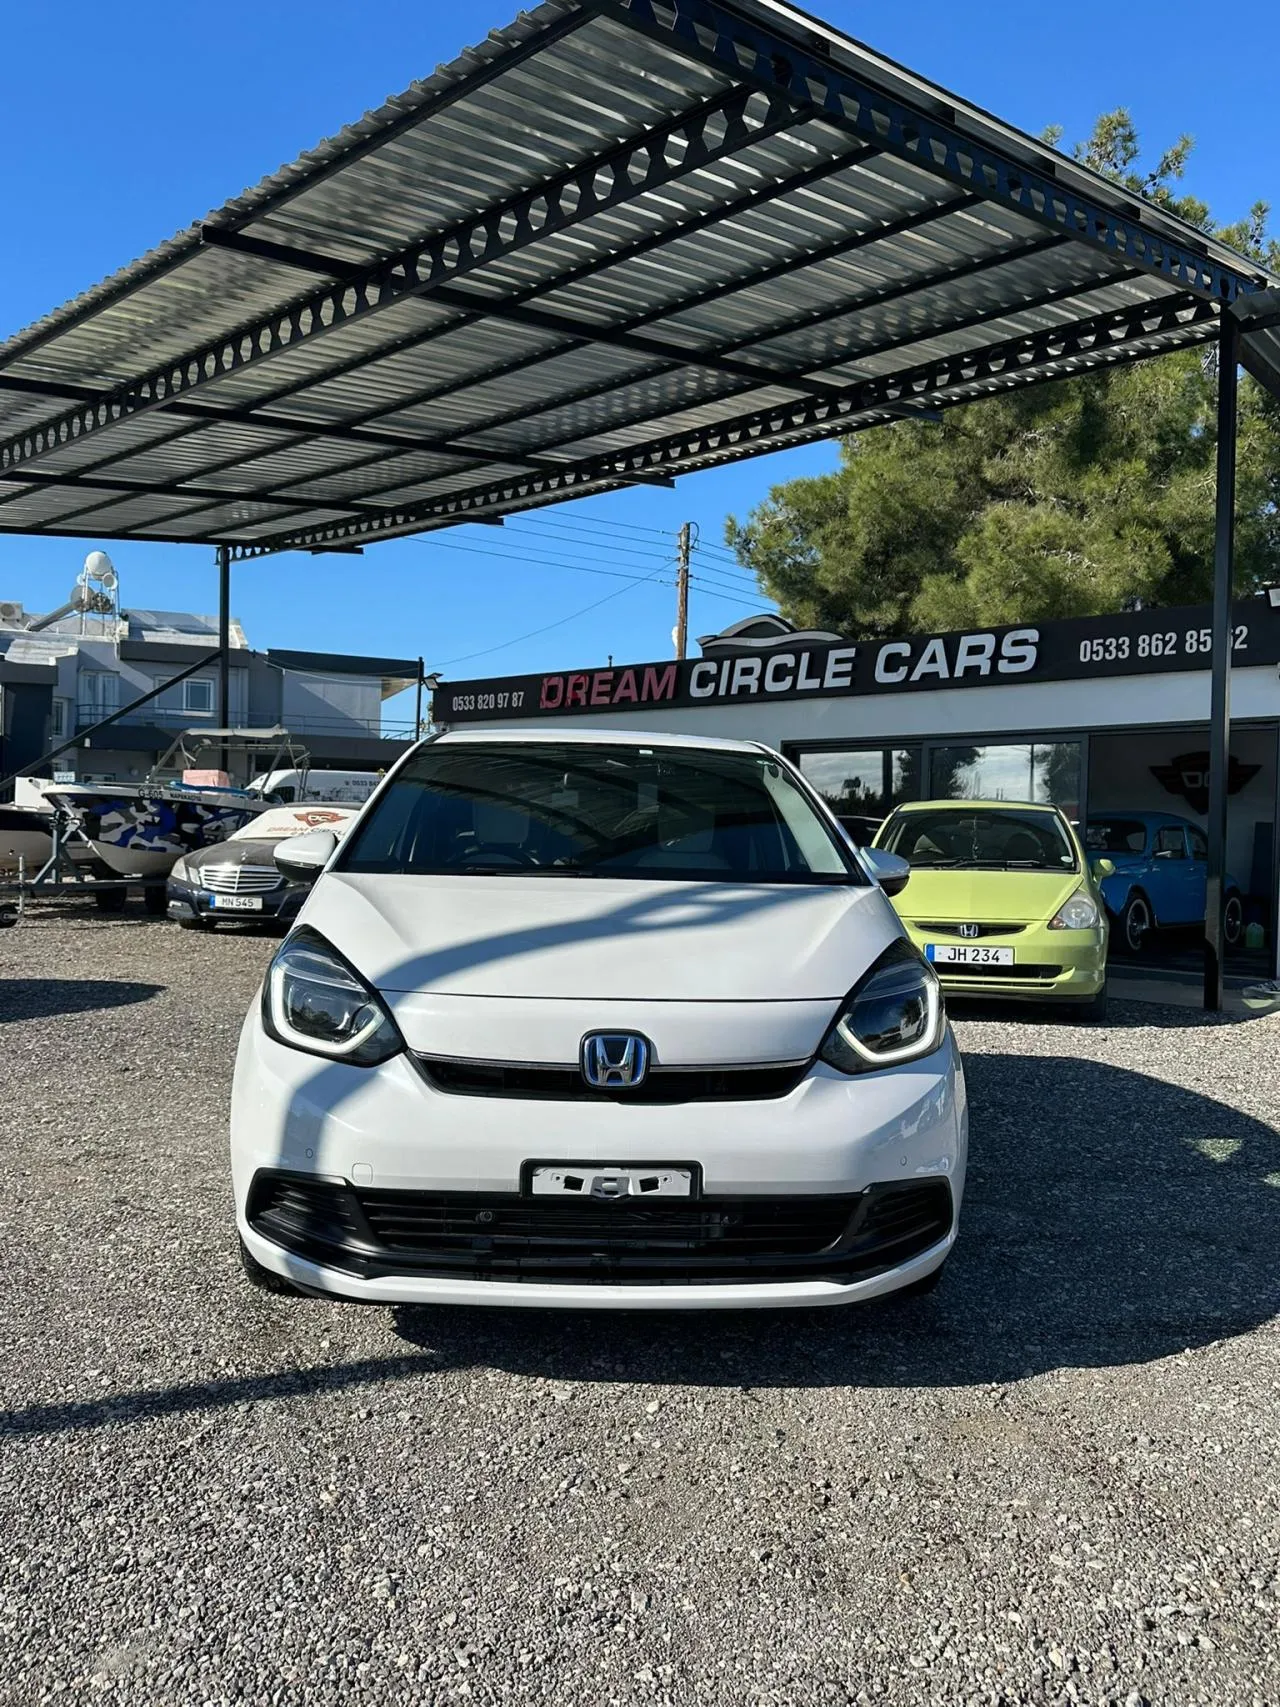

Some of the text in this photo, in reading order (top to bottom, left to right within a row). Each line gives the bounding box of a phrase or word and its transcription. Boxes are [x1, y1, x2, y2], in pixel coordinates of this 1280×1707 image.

[1079, 636, 1130, 662] 0533
[1137, 632, 1177, 657] 862
[1184, 628, 1212, 653] 85
[539, 628, 1040, 709] DREAM CIRCLE CARS
[452, 691, 525, 711] 0533 820 97 87
[235, 898, 254, 908] 545
[947, 947, 1000, 963] JH 234
